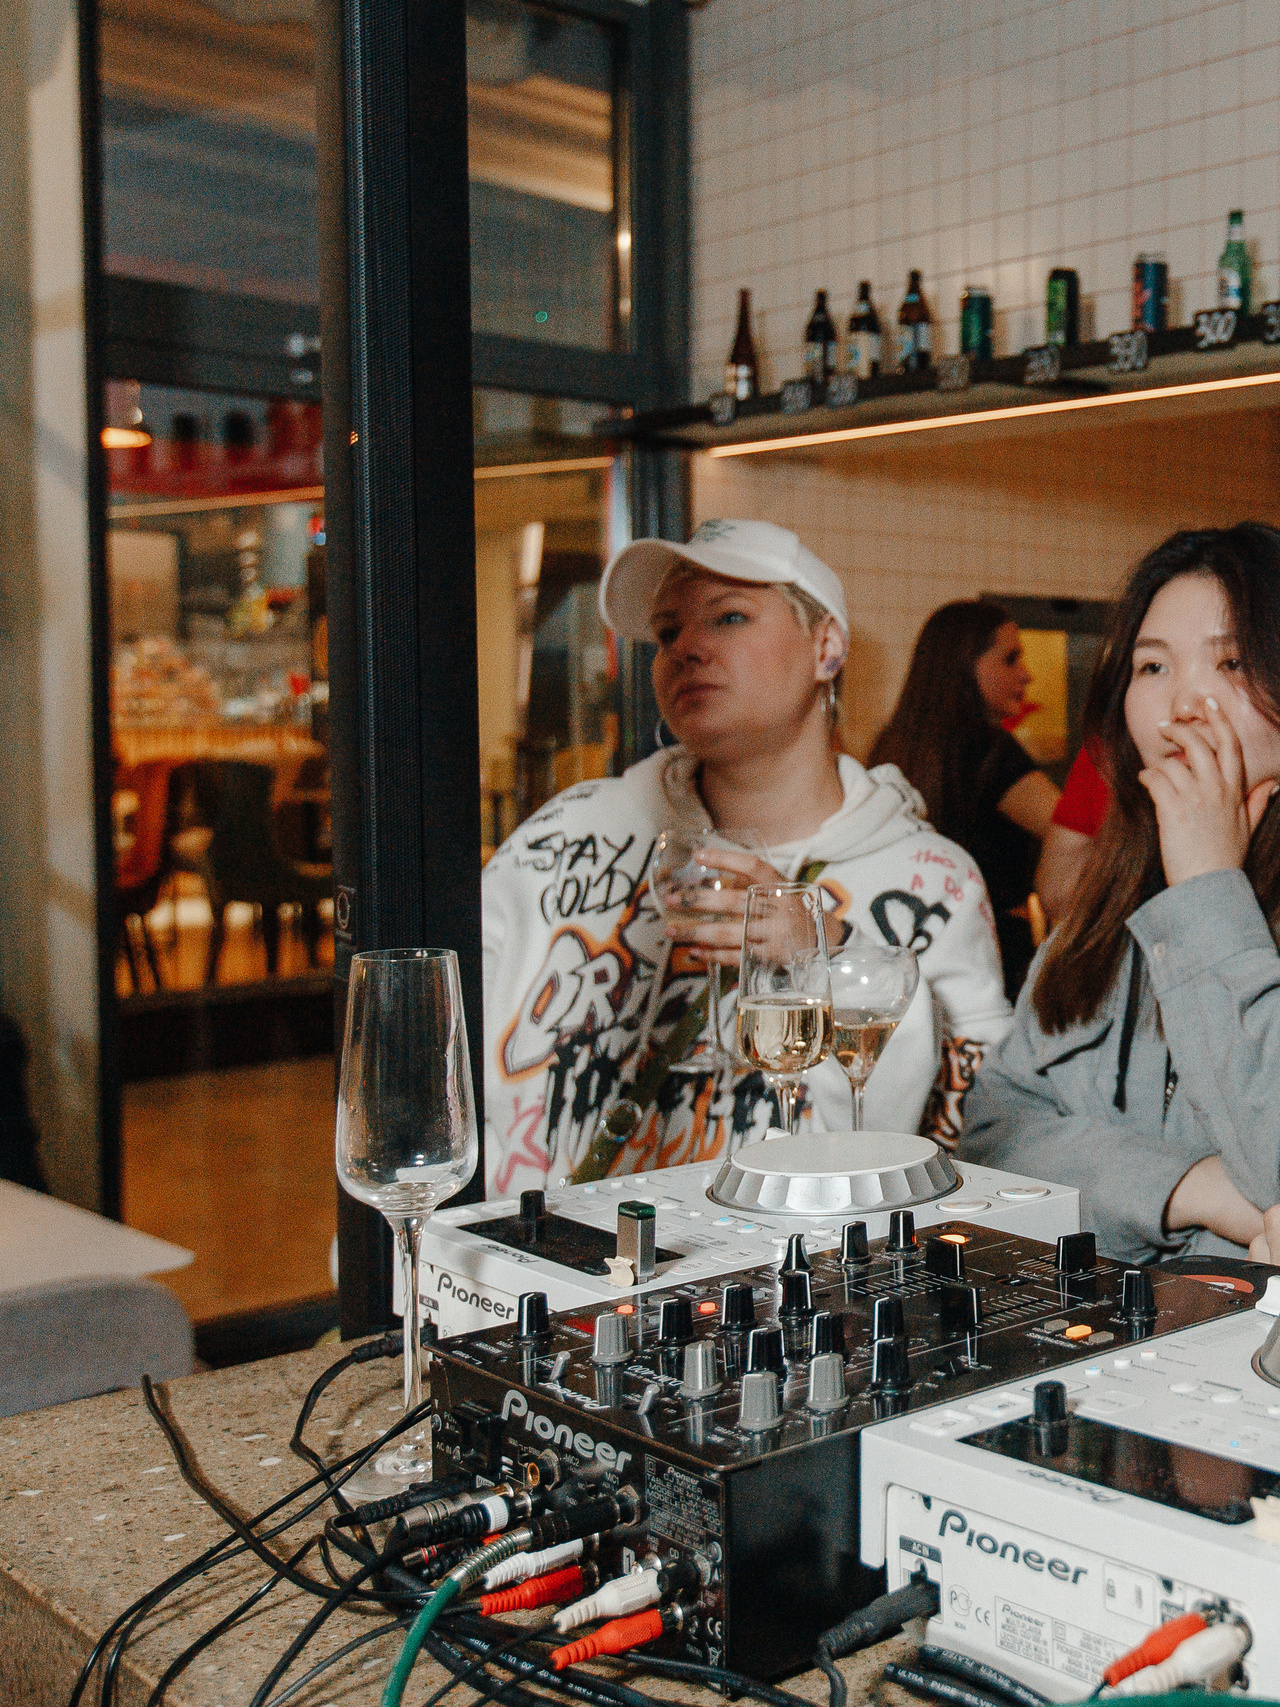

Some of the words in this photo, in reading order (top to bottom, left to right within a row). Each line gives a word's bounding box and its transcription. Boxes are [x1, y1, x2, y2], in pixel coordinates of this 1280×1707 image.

[527, 831, 635, 887] STAY
[437, 1272, 515, 1320] Pioneer
[501, 1389, 633, 1473] Pioneer
[938, 1508, 1088, 1585] Pioneer
[1001, 1603, 1046, 1628] Pioneer
